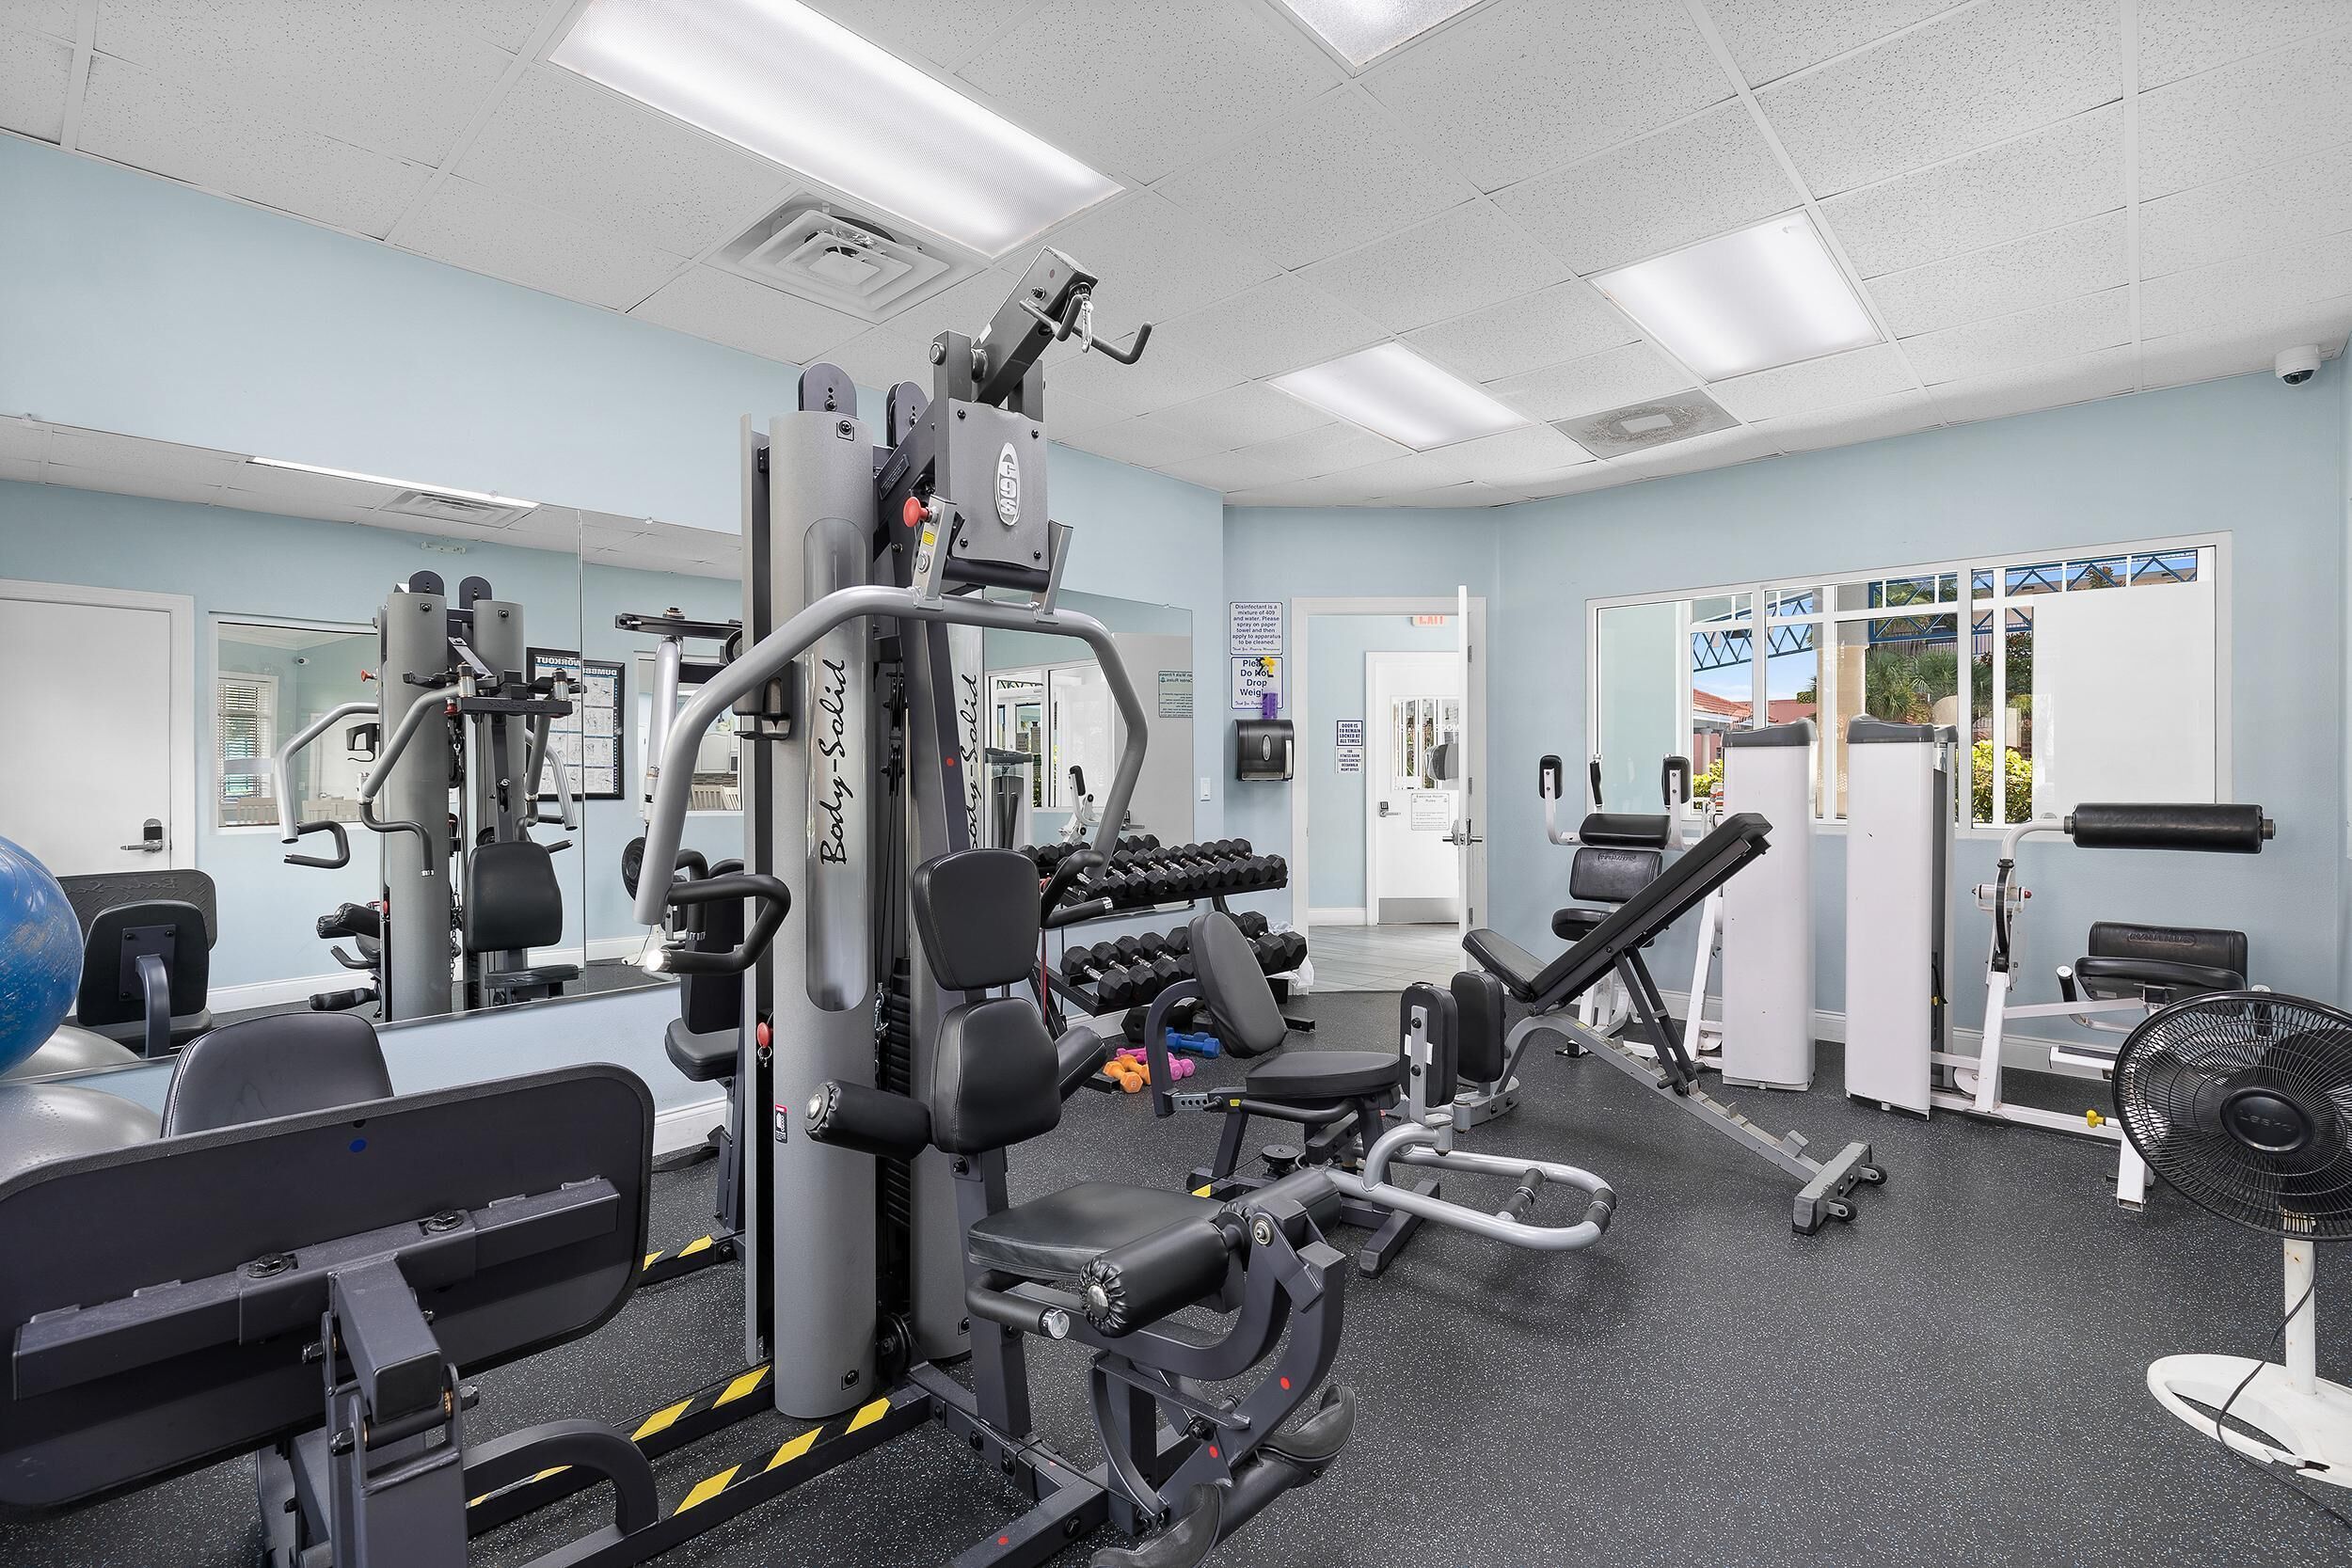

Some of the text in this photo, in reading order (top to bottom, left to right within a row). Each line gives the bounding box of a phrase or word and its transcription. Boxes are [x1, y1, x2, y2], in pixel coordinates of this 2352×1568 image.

[1240, 669, 1253, 677] Do
[1247, 678, 1267, 689] Drop
[818, 658, 853, 864] Body-Solid
